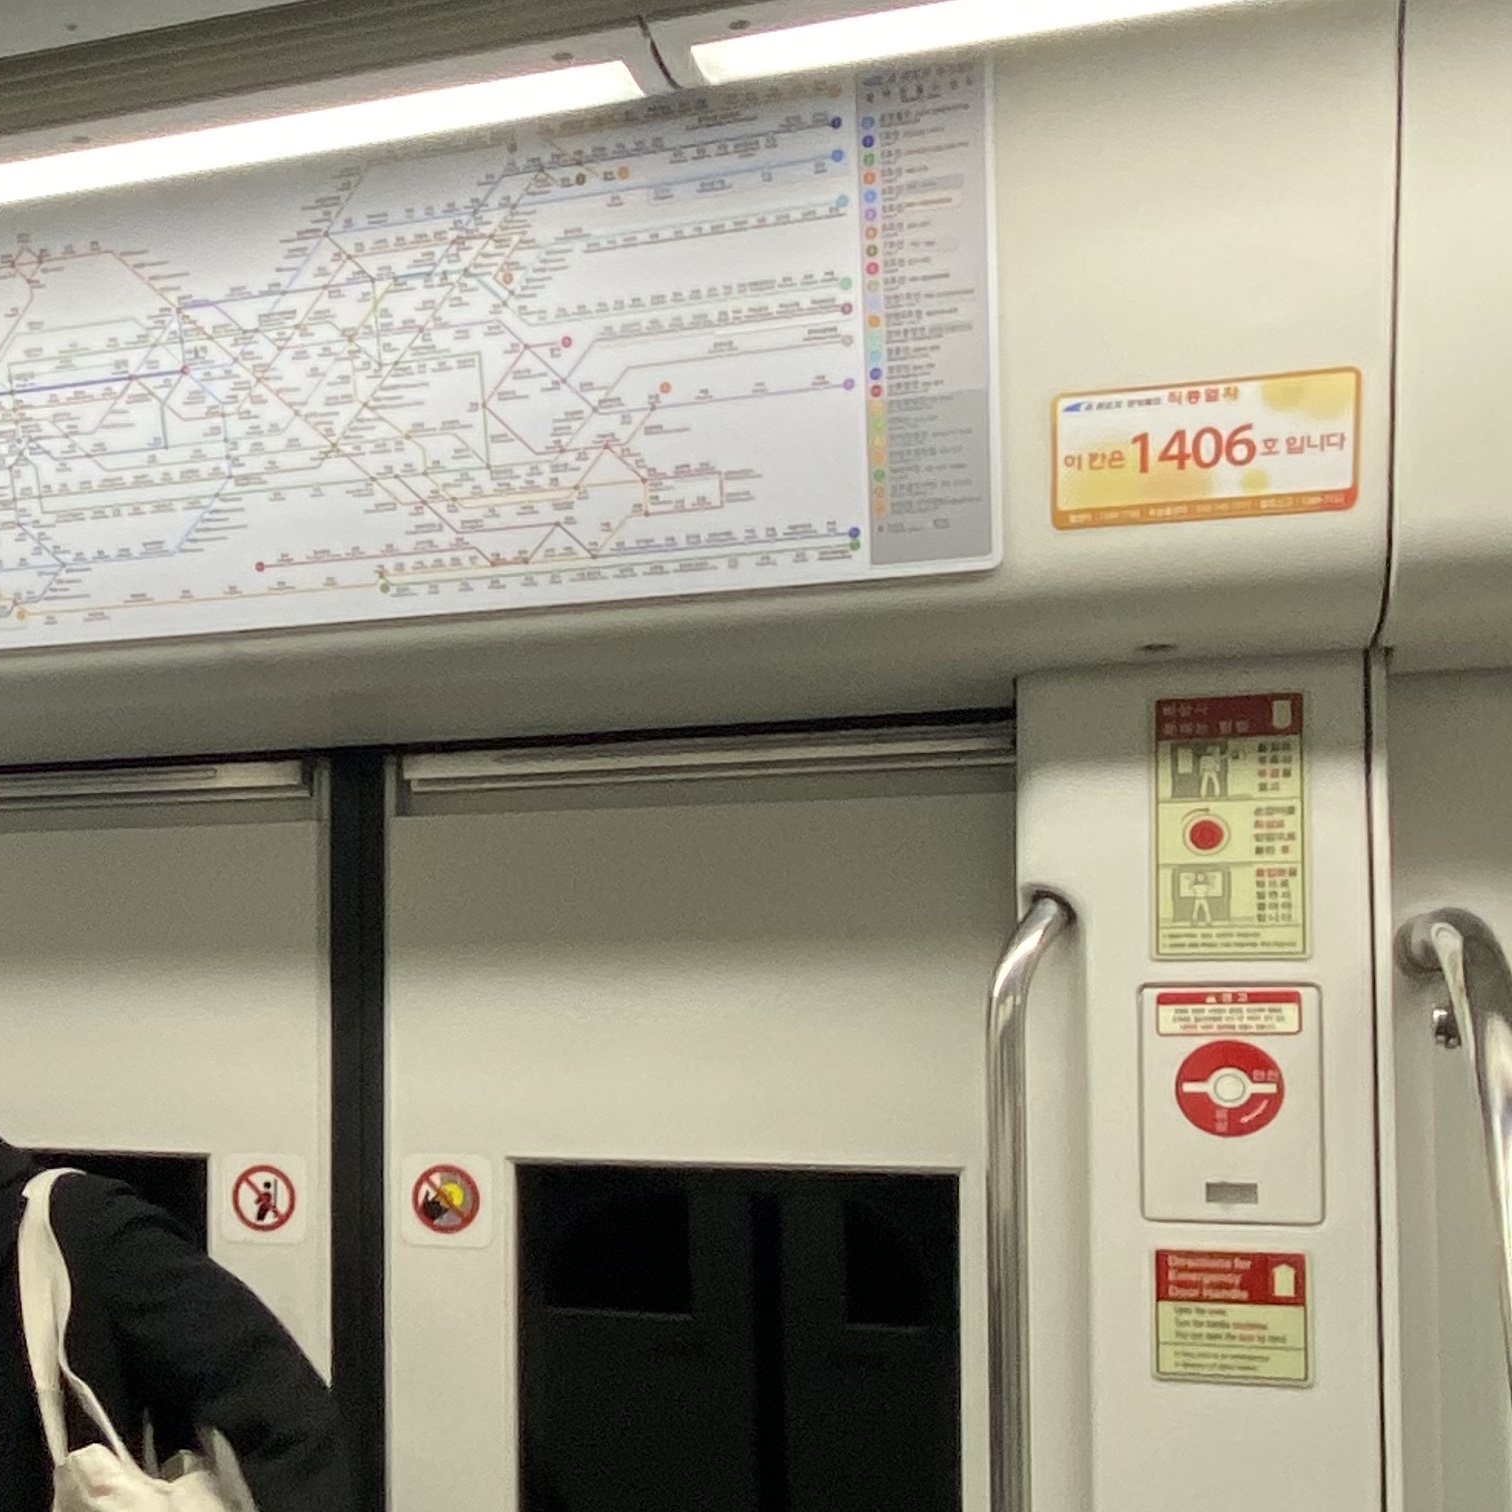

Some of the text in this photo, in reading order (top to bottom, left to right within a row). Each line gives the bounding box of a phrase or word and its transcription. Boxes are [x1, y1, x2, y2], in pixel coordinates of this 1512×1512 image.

[1063, 453, 1083, 471] 이
[1088, 449, 1126, 470] 칸은
[1285, 432, 1346, 455] 입니다
